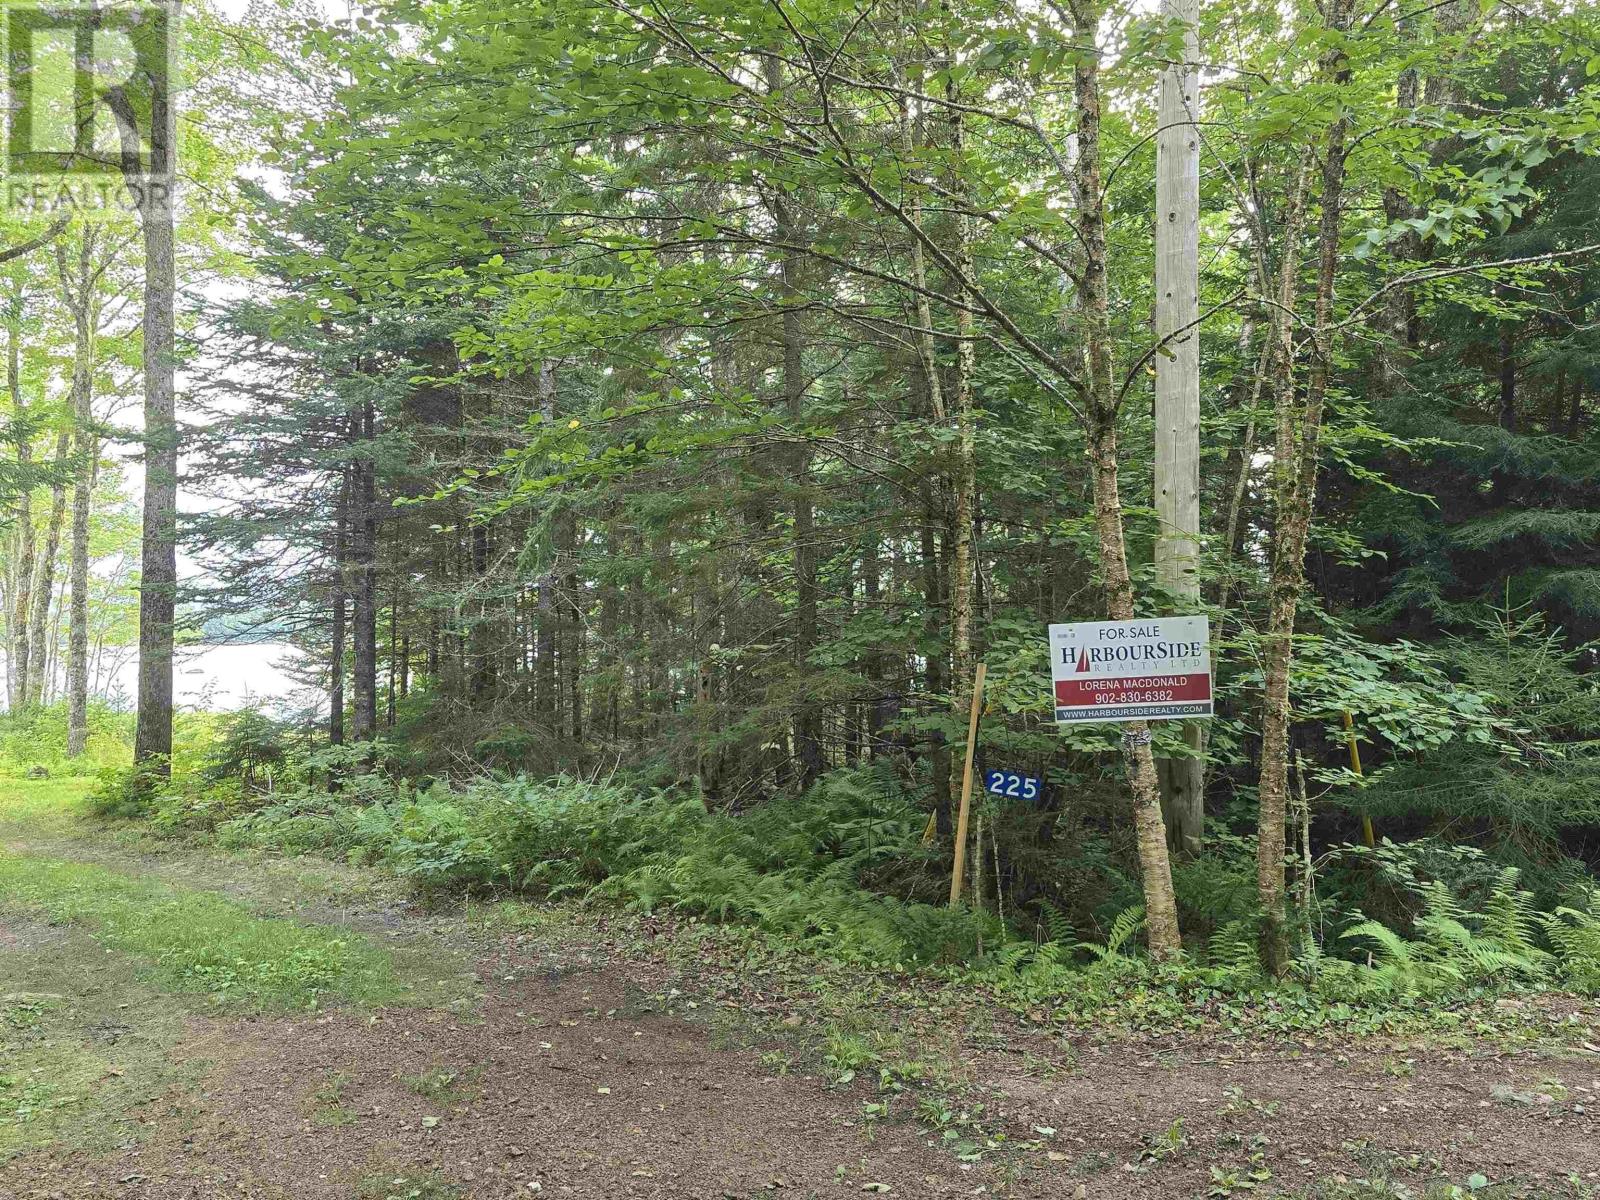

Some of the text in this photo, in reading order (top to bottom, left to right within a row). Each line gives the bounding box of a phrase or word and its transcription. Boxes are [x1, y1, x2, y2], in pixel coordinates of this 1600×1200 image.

[1099, 626, 1160, 640] FOR SALE
[1094, 660, 1201, 672] REALTY LTD
[1079, 676, 1188, 691] LORENA MACDONALD
[1095, 690, 1173, 704] 902-830-6382
[1063, 705, 1203, 719] WWW.HARBOURSIDEREALTY.COM
[990, 772, 1037, 798] 225
